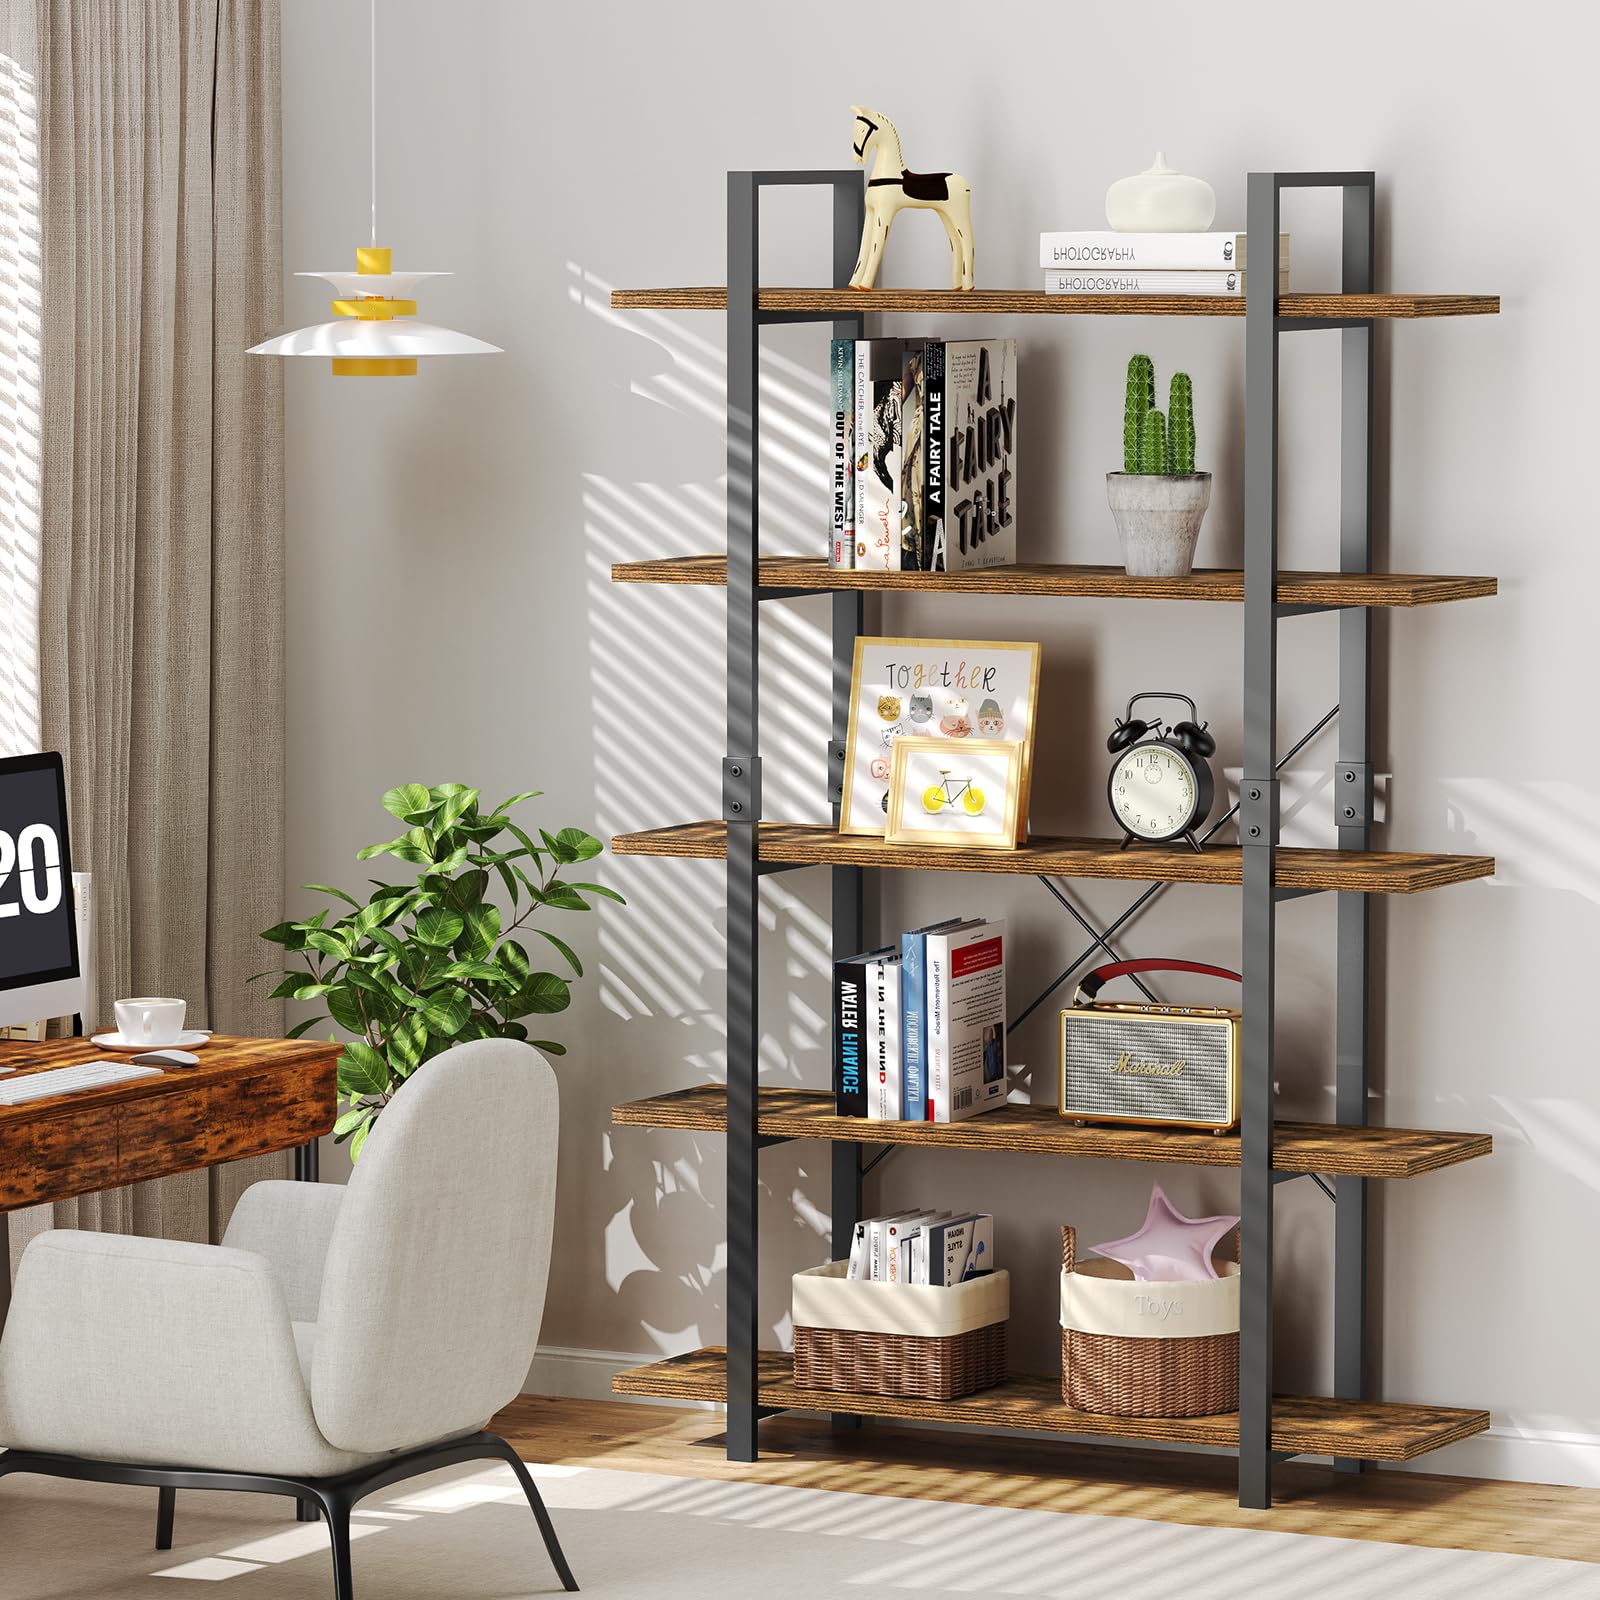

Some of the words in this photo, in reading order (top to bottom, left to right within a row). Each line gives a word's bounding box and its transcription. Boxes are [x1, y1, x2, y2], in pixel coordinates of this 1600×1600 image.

[977, 346, 992, 407] A
[929, 392, 941, 434] TALE
[835, 411, 845, 439] OUT
[835, 442, 845, 460] OF
[950, 397, 1016, 493] FAIRY
[929, 437, 941, 487] FAIRY
[834, 462, 845, 488] THE
[929, 490, 941, 504] A
[834, 491, 844, 531] WEST
[857, 491, 865, 525] SALINGER
[954, 468, 1013, 557] TALE
[1136, 758, 1144, 768] 11
[1149, 754, 1159, 764] 12
[1167, 759, 1170, 768] 1
[1125, 770, 1133, 779] 10
[1178, 771, 1184, 780] 2
[1119, 786, 1125, 796] 9
[1182, 787, 1188, 797] 3
[1123, 803, 1130, 812] 8
[1177, 804, 1183, 814] 4
[1135, 814, 1142, 824] 7
[1150, 819, 1157, 829] 6
[1167, 815, 1174, 825] 5
[1108, 1050, 1186, 1077] Marshall
[1134, 1295, 1184, 1320] Toys
